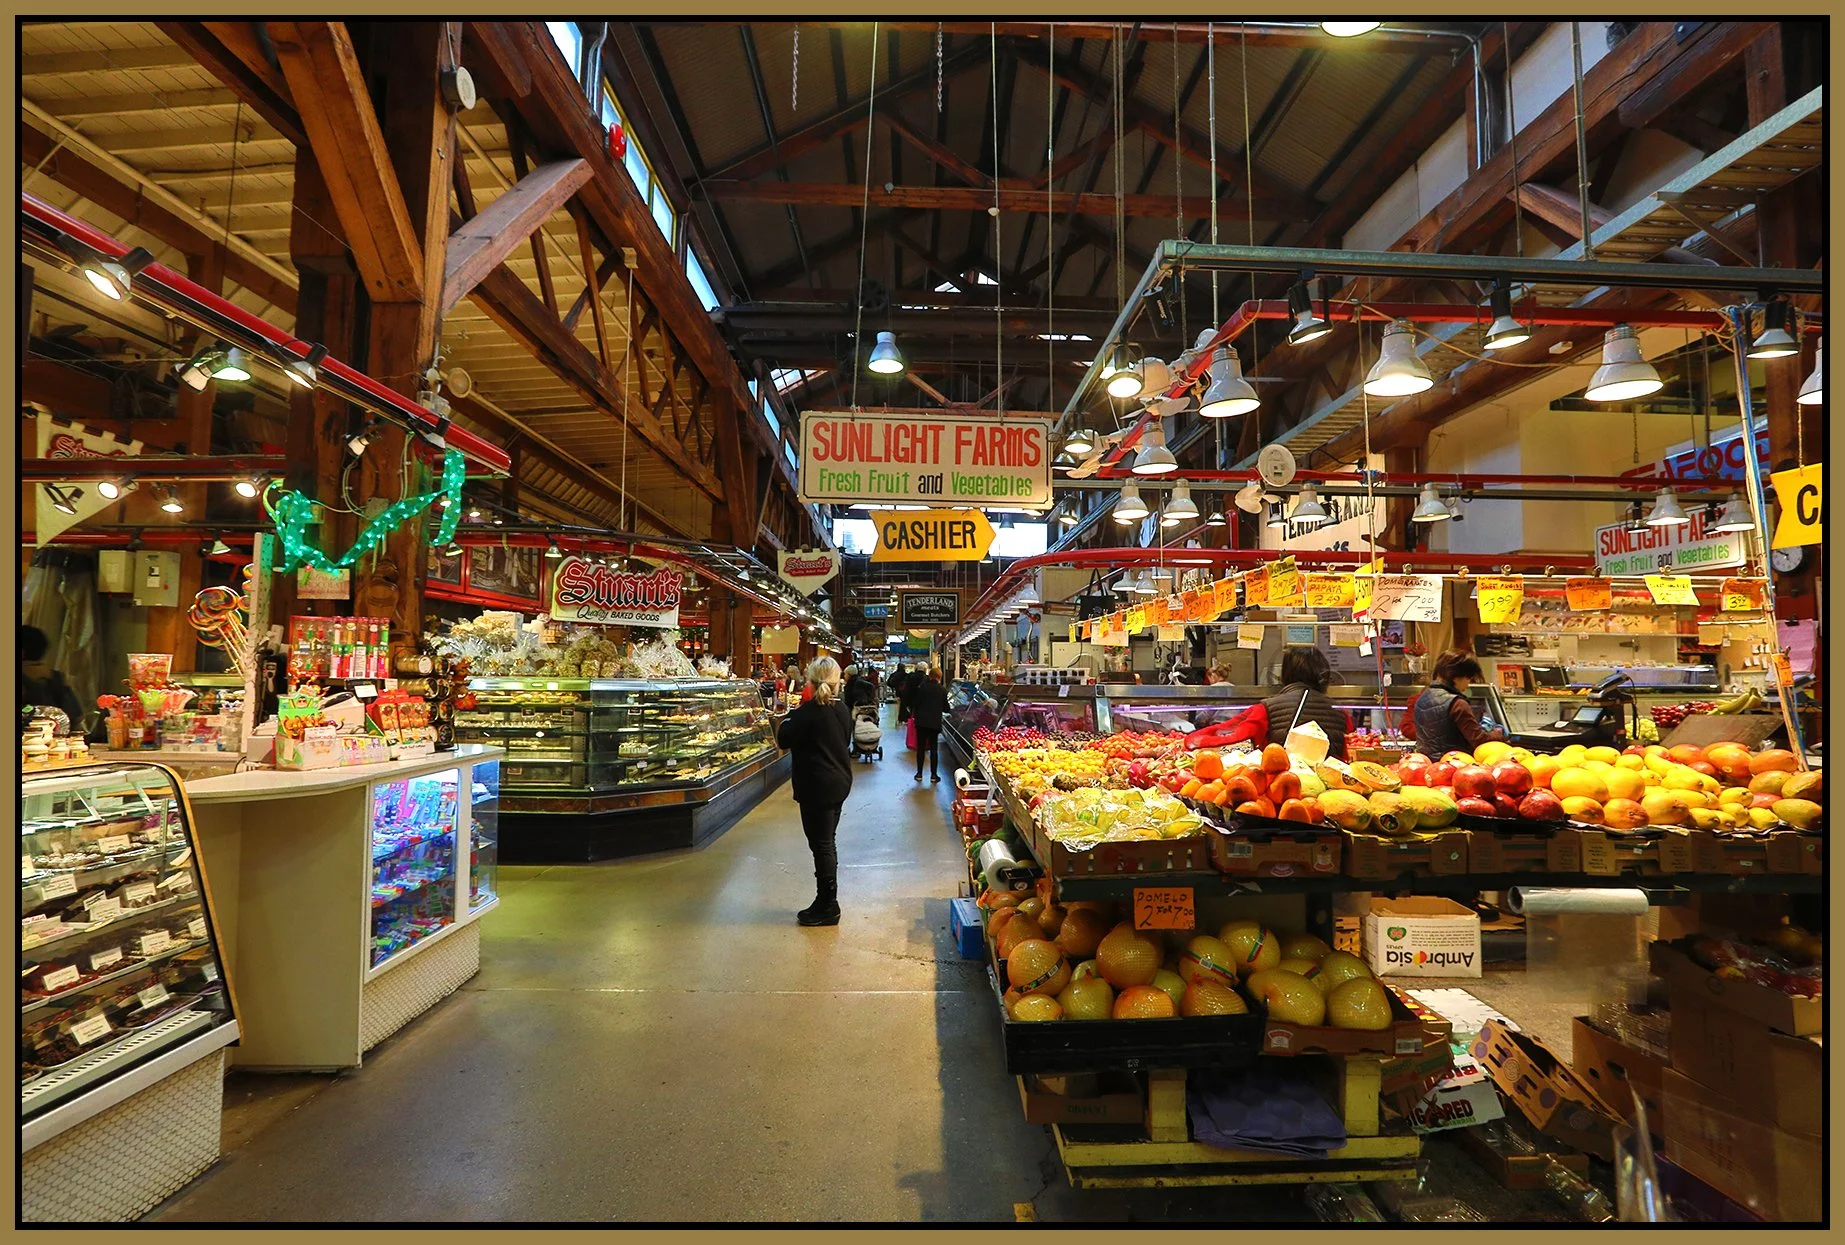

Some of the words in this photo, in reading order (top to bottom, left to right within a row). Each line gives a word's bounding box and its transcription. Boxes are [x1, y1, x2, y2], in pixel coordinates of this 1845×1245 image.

[812, 421, 945, 464] SUNLIGHT
[955, 425, 1041, 467] FARMS
[819, 468, 861, 493] Fresh
[868, 469, 910, 494] Fruit
[917, 472, 943, 495] and
[951, 471, 1033, 497] Vegetables
[1797, 484, 1822, 526] C
[883, 520, 976, 550] CASHIER
[1605, 559, 1628, 574] Fresh
[1630, 554, 1654, 571] Fruit
[1657, 551, 1673, 567] and
[1676, 544, 1730, 564] Vegetables
[558, 561, 683, 609] Stuart's
[1309, 583, 1343, 594] PAPAYA
[907, 596, 954, 608] TENDERLAND
[1372, 595, 1391, 614] 2
[610, 611, 633, 620] BAKED
[635, 613, 660, 622] GOODS
[1137, 891, 1187, 904] POMELO
[1140, 904, 1153, 928] 2
[1442, 1098, 1474, 1120] RED
